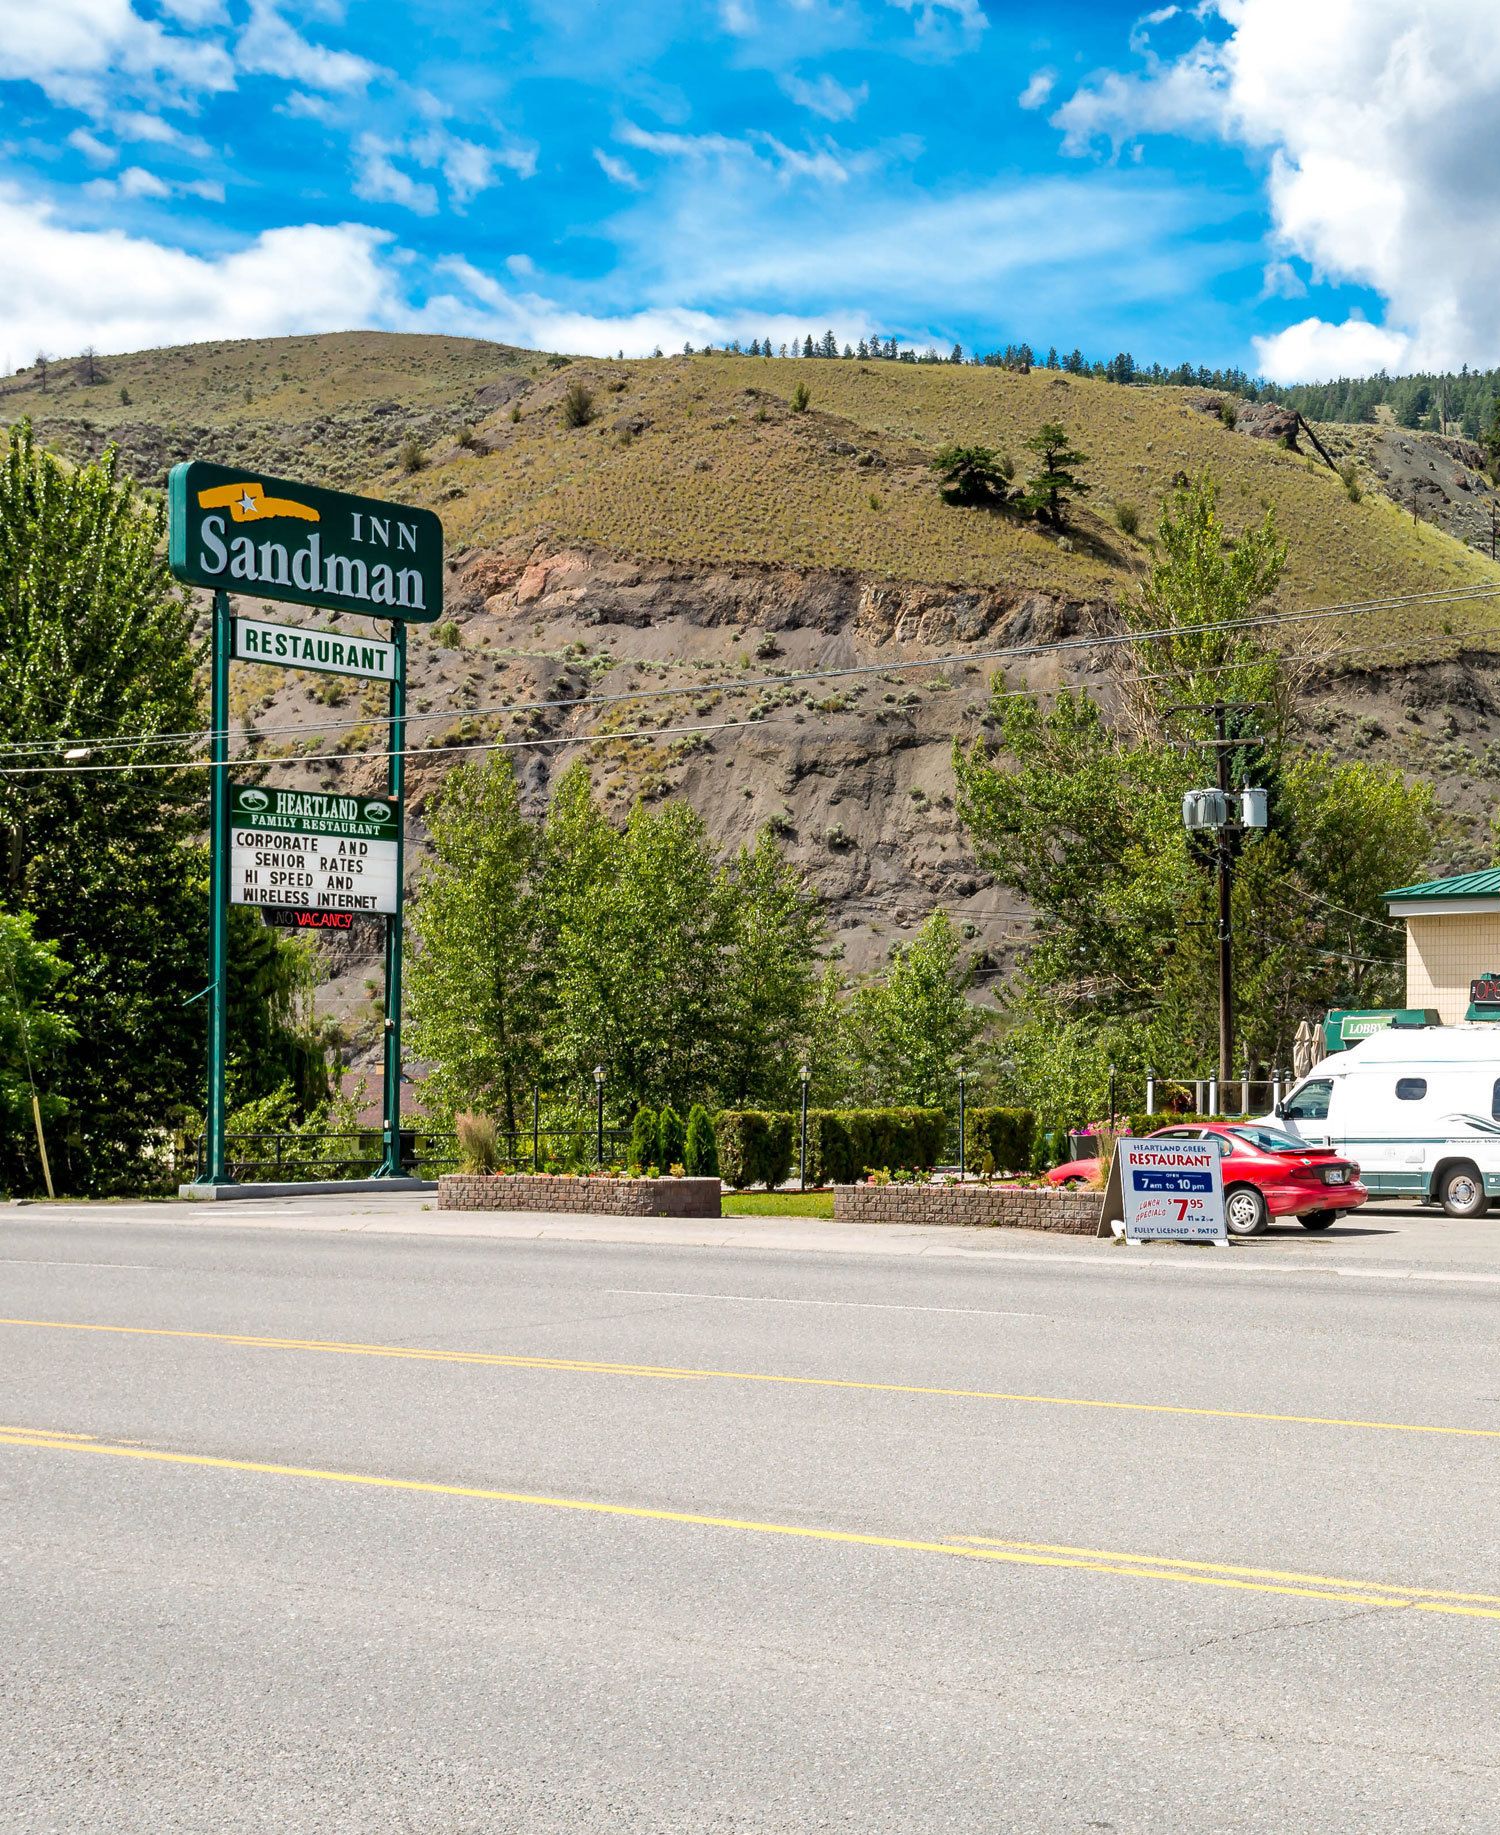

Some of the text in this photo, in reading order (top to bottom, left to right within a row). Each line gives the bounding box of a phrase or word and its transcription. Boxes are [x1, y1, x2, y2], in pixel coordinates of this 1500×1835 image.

[351, 511, 419, 553] INN
[200, 515, 427, 610] Sandman
[245, 628, 388, 671] RESTAURANT
[276, 792, 359, 820] HEARTLAND
[251, 814, 381, 835] FAMILY RESTAURANT
[236, 832, 369, 856] CORPORATE AND
[254, 851, 364, 873] SENIOR RATES
[245, 869, 354, 890] HI SPEED AND
[243, 888, 378, 909] WIRELESS INTERNET
[274, 911, 353, 928] NO VACANCY
[1133, 1144, 1181, 1152] HEARTLAND
[1129, 1153, 1212, 1167] RESTAURANT
[1139, 1198, 1161, 1210] LUNCH
[1135, 1209, 1167, 1222] SPECIALS
